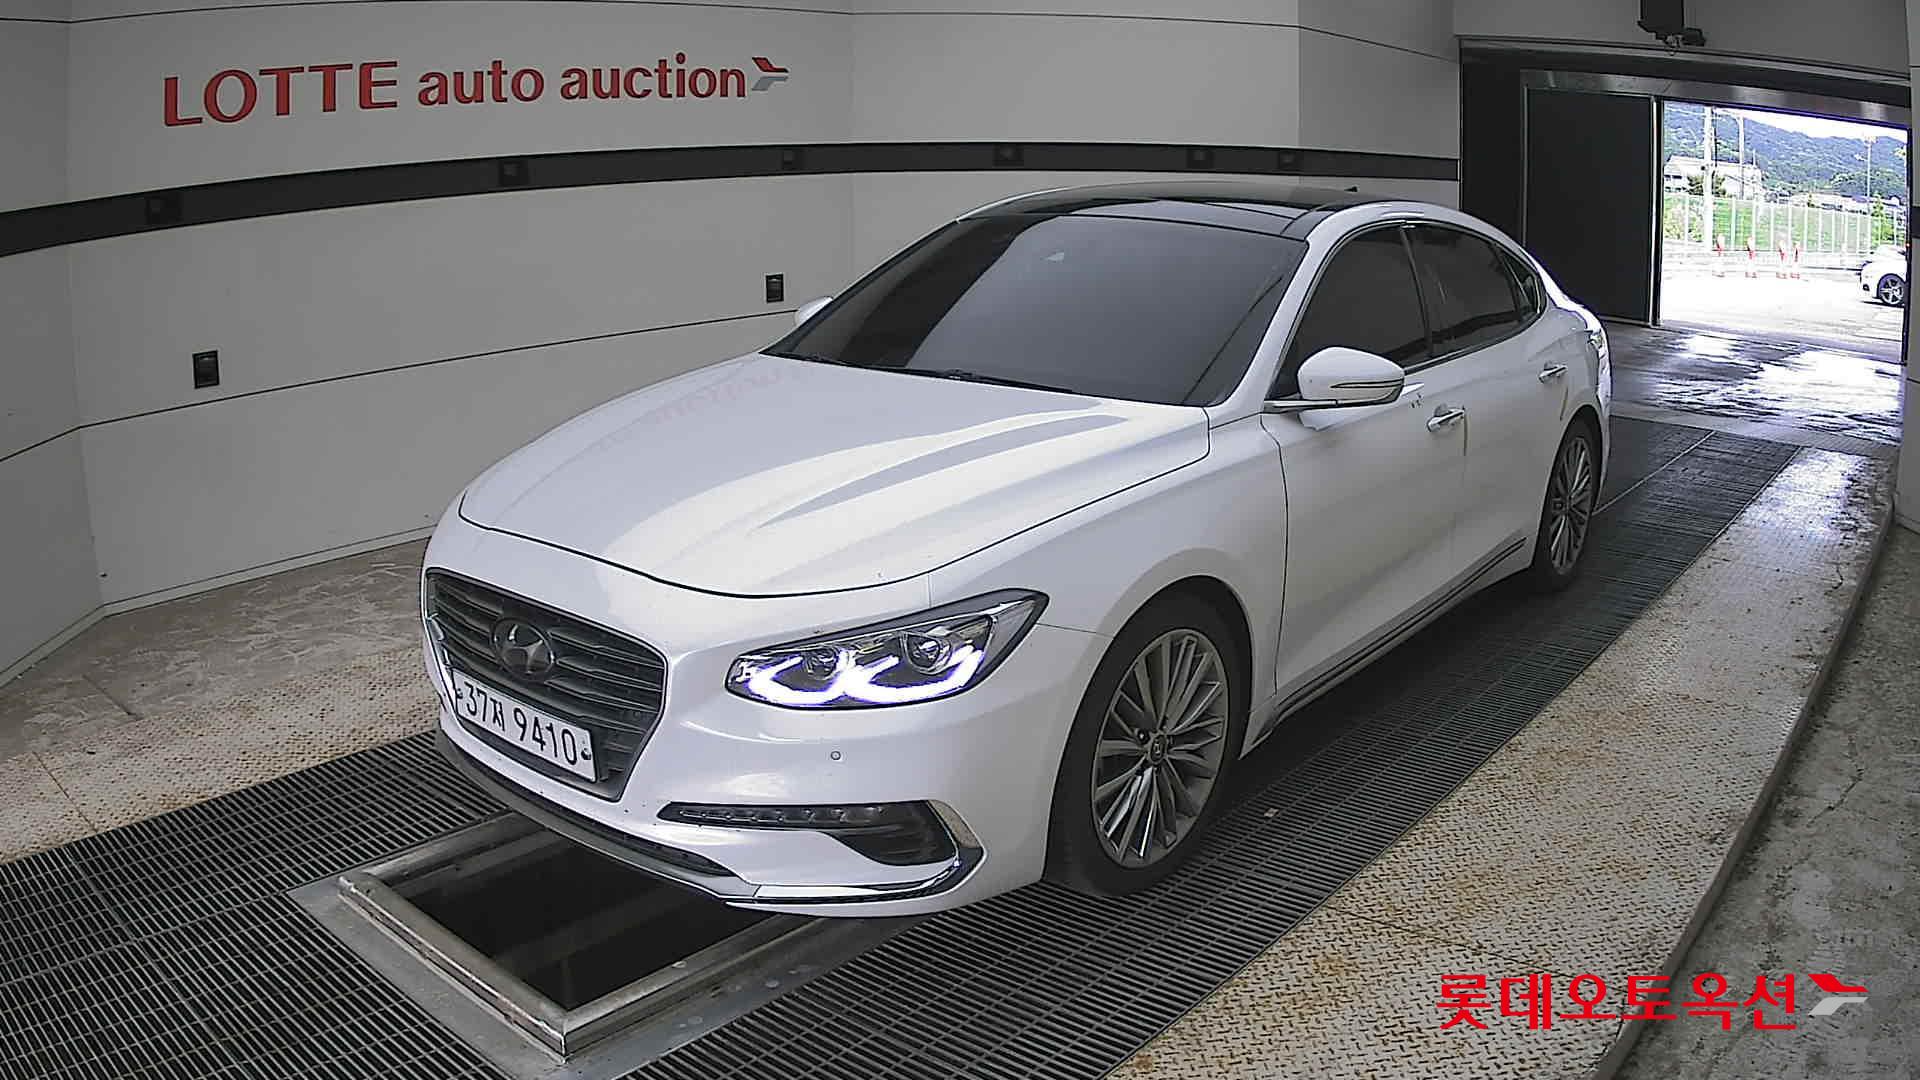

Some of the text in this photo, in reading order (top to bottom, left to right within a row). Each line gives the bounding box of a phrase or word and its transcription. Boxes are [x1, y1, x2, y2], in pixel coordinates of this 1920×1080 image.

[163, 52, 747, 127] LOTTE auto auction
[513, 707, 577, 766] 9410
